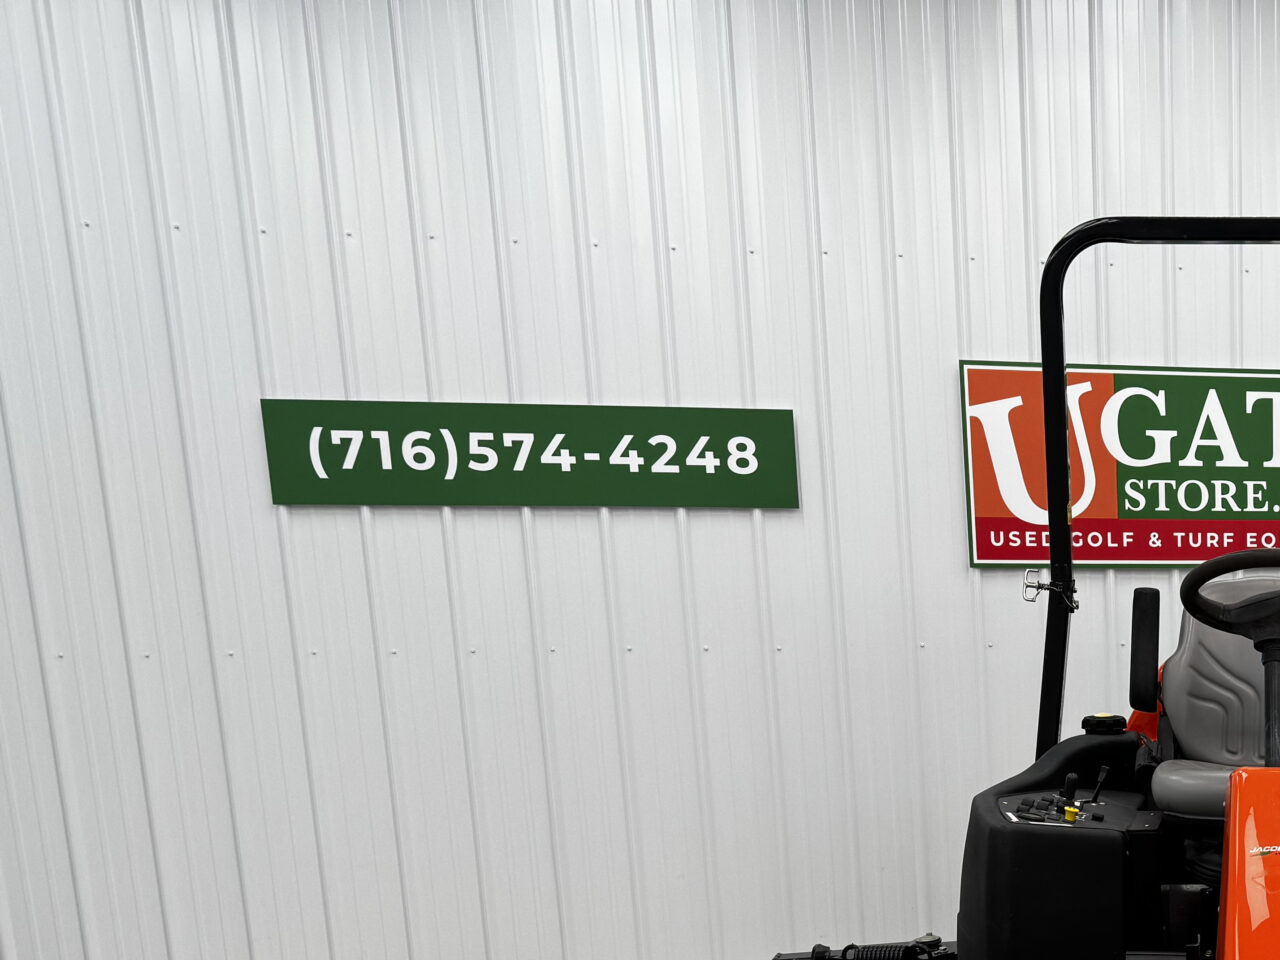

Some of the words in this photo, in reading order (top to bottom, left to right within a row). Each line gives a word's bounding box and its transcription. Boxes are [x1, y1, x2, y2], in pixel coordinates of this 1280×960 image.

[309, 426, 759, 480] (716)574-4248
[1072, 531, 1134, 547] GOLF
[1148, 532, 1162, 547] &
[1173, 532, 1234, 548] TURF
